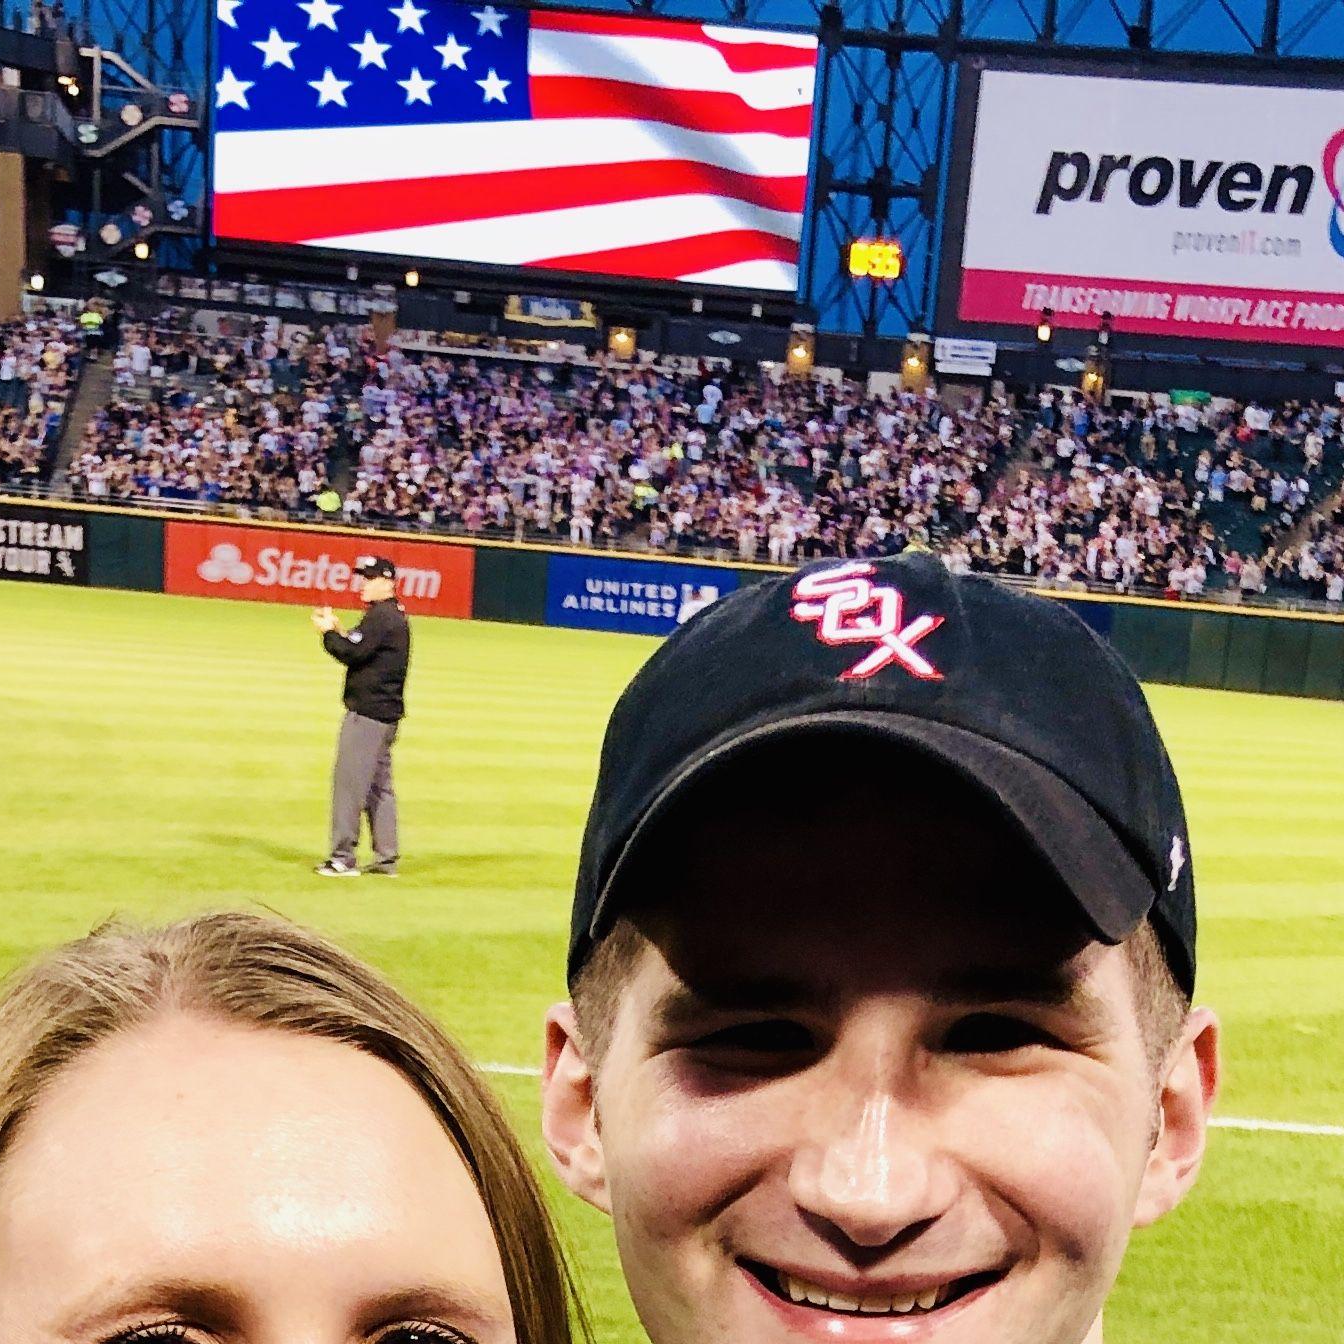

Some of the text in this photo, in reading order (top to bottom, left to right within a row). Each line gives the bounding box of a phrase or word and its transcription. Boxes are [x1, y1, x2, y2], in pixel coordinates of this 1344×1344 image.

[1035, 149, 1315, 215] proven
[1022, 283, 1172, 320] TRANSFORMING
[1173, 294, 1291, 329] WORKPLACE
[256, 548, 351, 591] State
[585, 578, 678, 600] UNITED
[561, 594, 677, 618] AIRLINES
[790, 562, 945, 681] SOX
